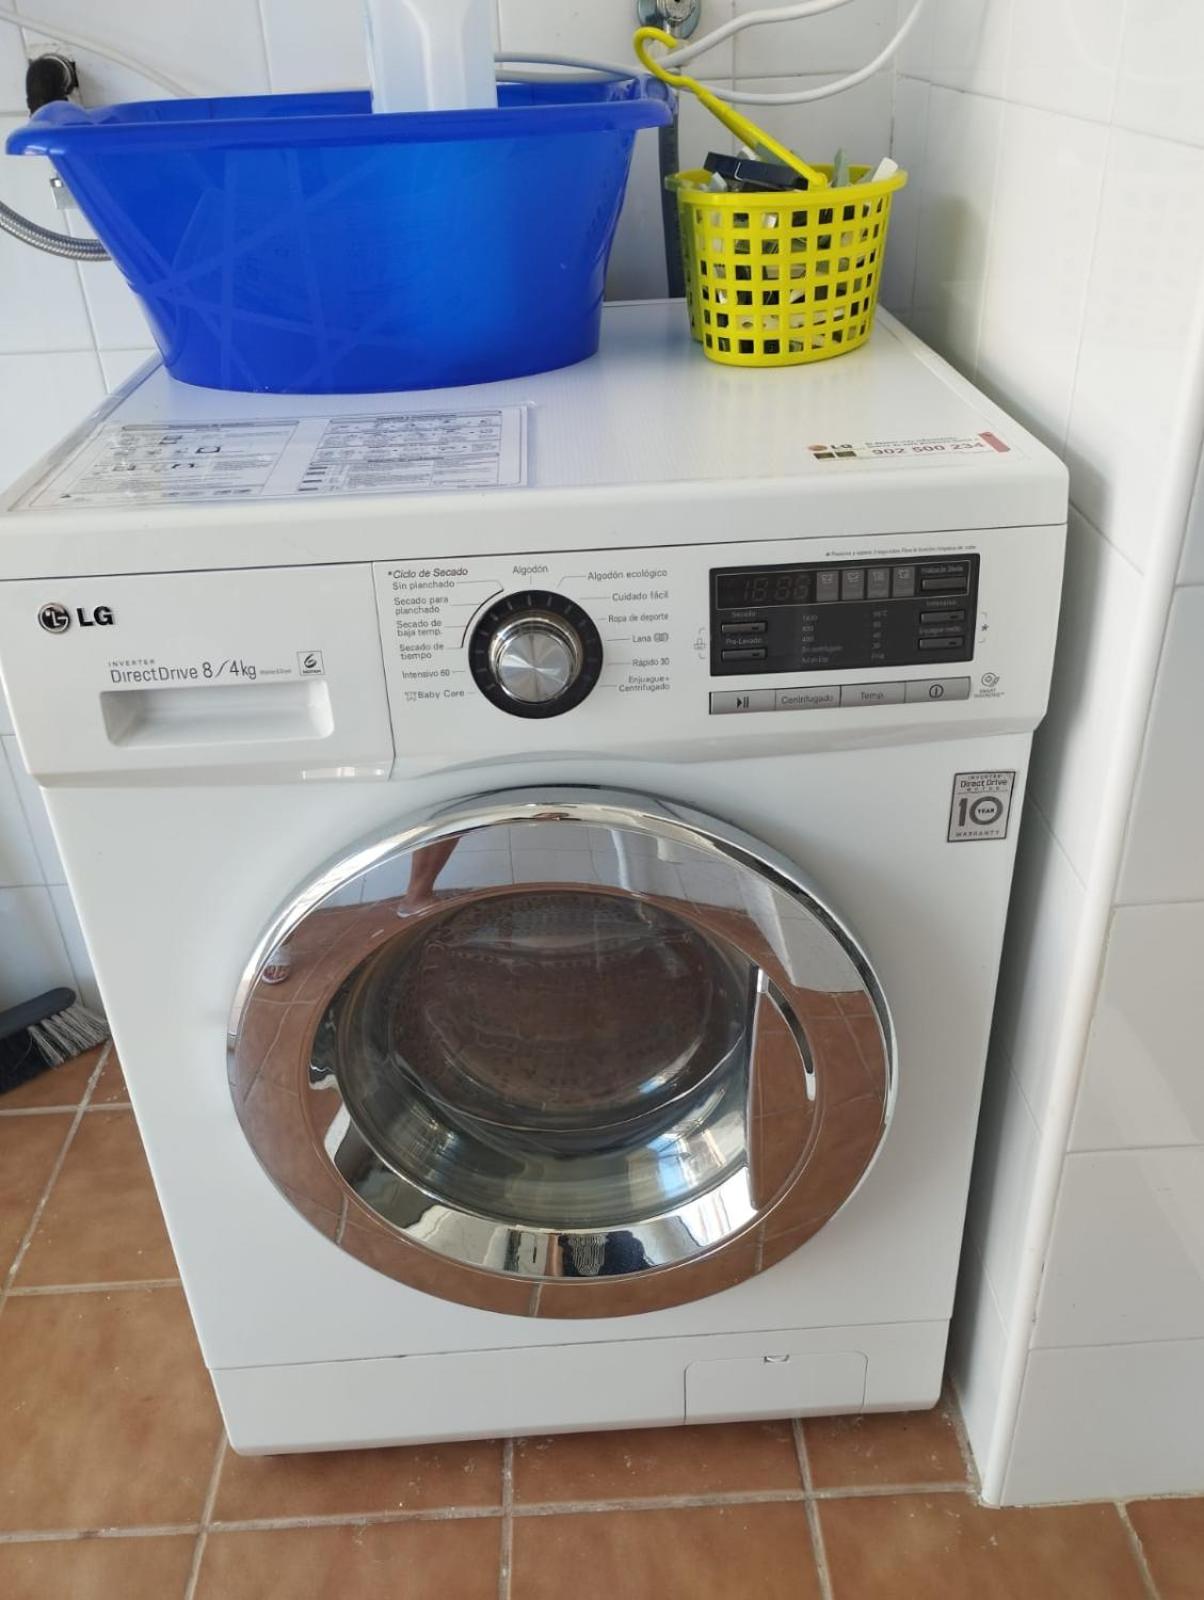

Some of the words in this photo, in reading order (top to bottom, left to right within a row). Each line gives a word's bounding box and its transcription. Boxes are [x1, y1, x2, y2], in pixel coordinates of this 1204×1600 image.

[872, 447, 906, 455] 902
[912, 444, 945, 452] 500
[418, 568, 430, 578] de
[433, 567, 468, 577] Secado
[512, 565, 548, 576] Algodón
[587, 570, 623, 582] Algodón
[626, 568, 668, 579] ecológico
[392, 582, 407, 591] Sin
[409, 580, 455, 591] planchado
[394, 597, 427, 606] Secado
[429, 597, 448, 606] para
[612, 593, 648, 602] Cuidado
[650, 590, 669, 600] fácil
[76, 605, 114, 627] LG
[395, 606, 440, 616] planchado
[608, 614, 627, 624] Ropa
[629, 613, 639, 622] de
[640, 612, 669, 623] deporte
[396, 620, 429, 629] Secado
[430, 619, 442, 628] de
[397, 628, 416, 638] baja
[632, 634, 652, 643] Lana
[399, 643, 431, 652] Secado
[433, 642, 444, 651] de
[401, 652, 432, 661] tiempo
[402, 670, 439, 679] Intensivo
[619, 683, 670, 693] Centrifugado
[418, 691, 441, 700] Baby
[443, 689, 465, 698] Care
[781, 694, 834, 705] Centrifugado
[960, 780, 985, 788] Direct
[986, 778, 1008, 786] Drive
[958, 796, 1004, 827] 10
